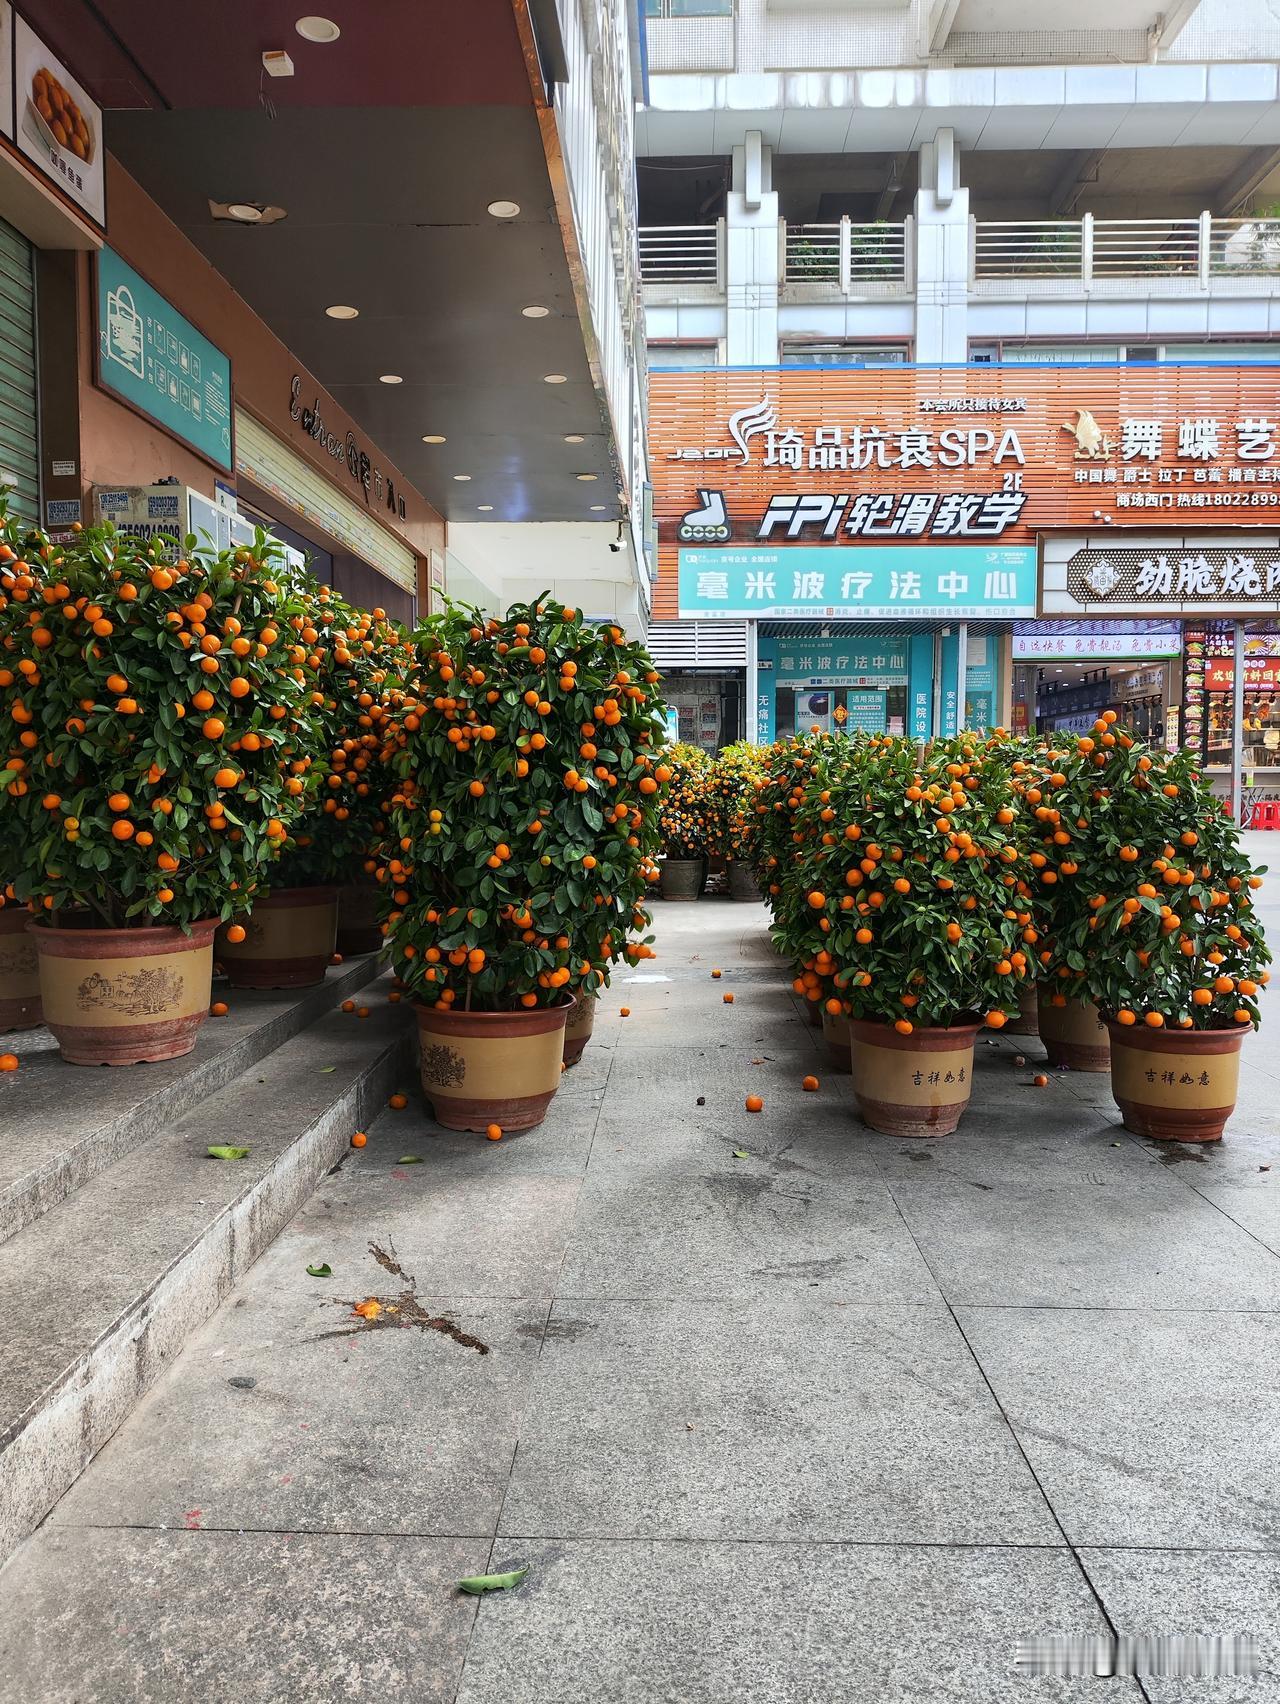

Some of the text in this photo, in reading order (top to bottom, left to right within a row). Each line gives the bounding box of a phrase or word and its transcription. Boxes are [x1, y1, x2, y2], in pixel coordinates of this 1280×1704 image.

[918, 398, 1027, 412] 本会所只接待女宾
[763, 426, 1026, 470] 琦品抗衰SPA
[1122, 418, 1277, 460] 舞蝶艺
[1003, 472, 1023, 492] 2F
[1074, 468, 1117, 482] 中国舞
[1123, 468, 1152, 482] 爵士
[1158, 468, 1187, 482] 拉丁
[1193, 468, 1222, 482] 芭蕾
[1116, 493, 1280, 507] 商场西门 热线18022899
[696, 571, 1017, 599] 毫米波疗法中心
[1018, 637, 1180, 652] 自选快餐 免费靓汤 免费小菜
[780, 655, 904, 670] 毫米波疗法中心
[911, 1066, 966, 1087] 吉祥如意
[1144, 1068, 1210, 1087] 吉祥如意
